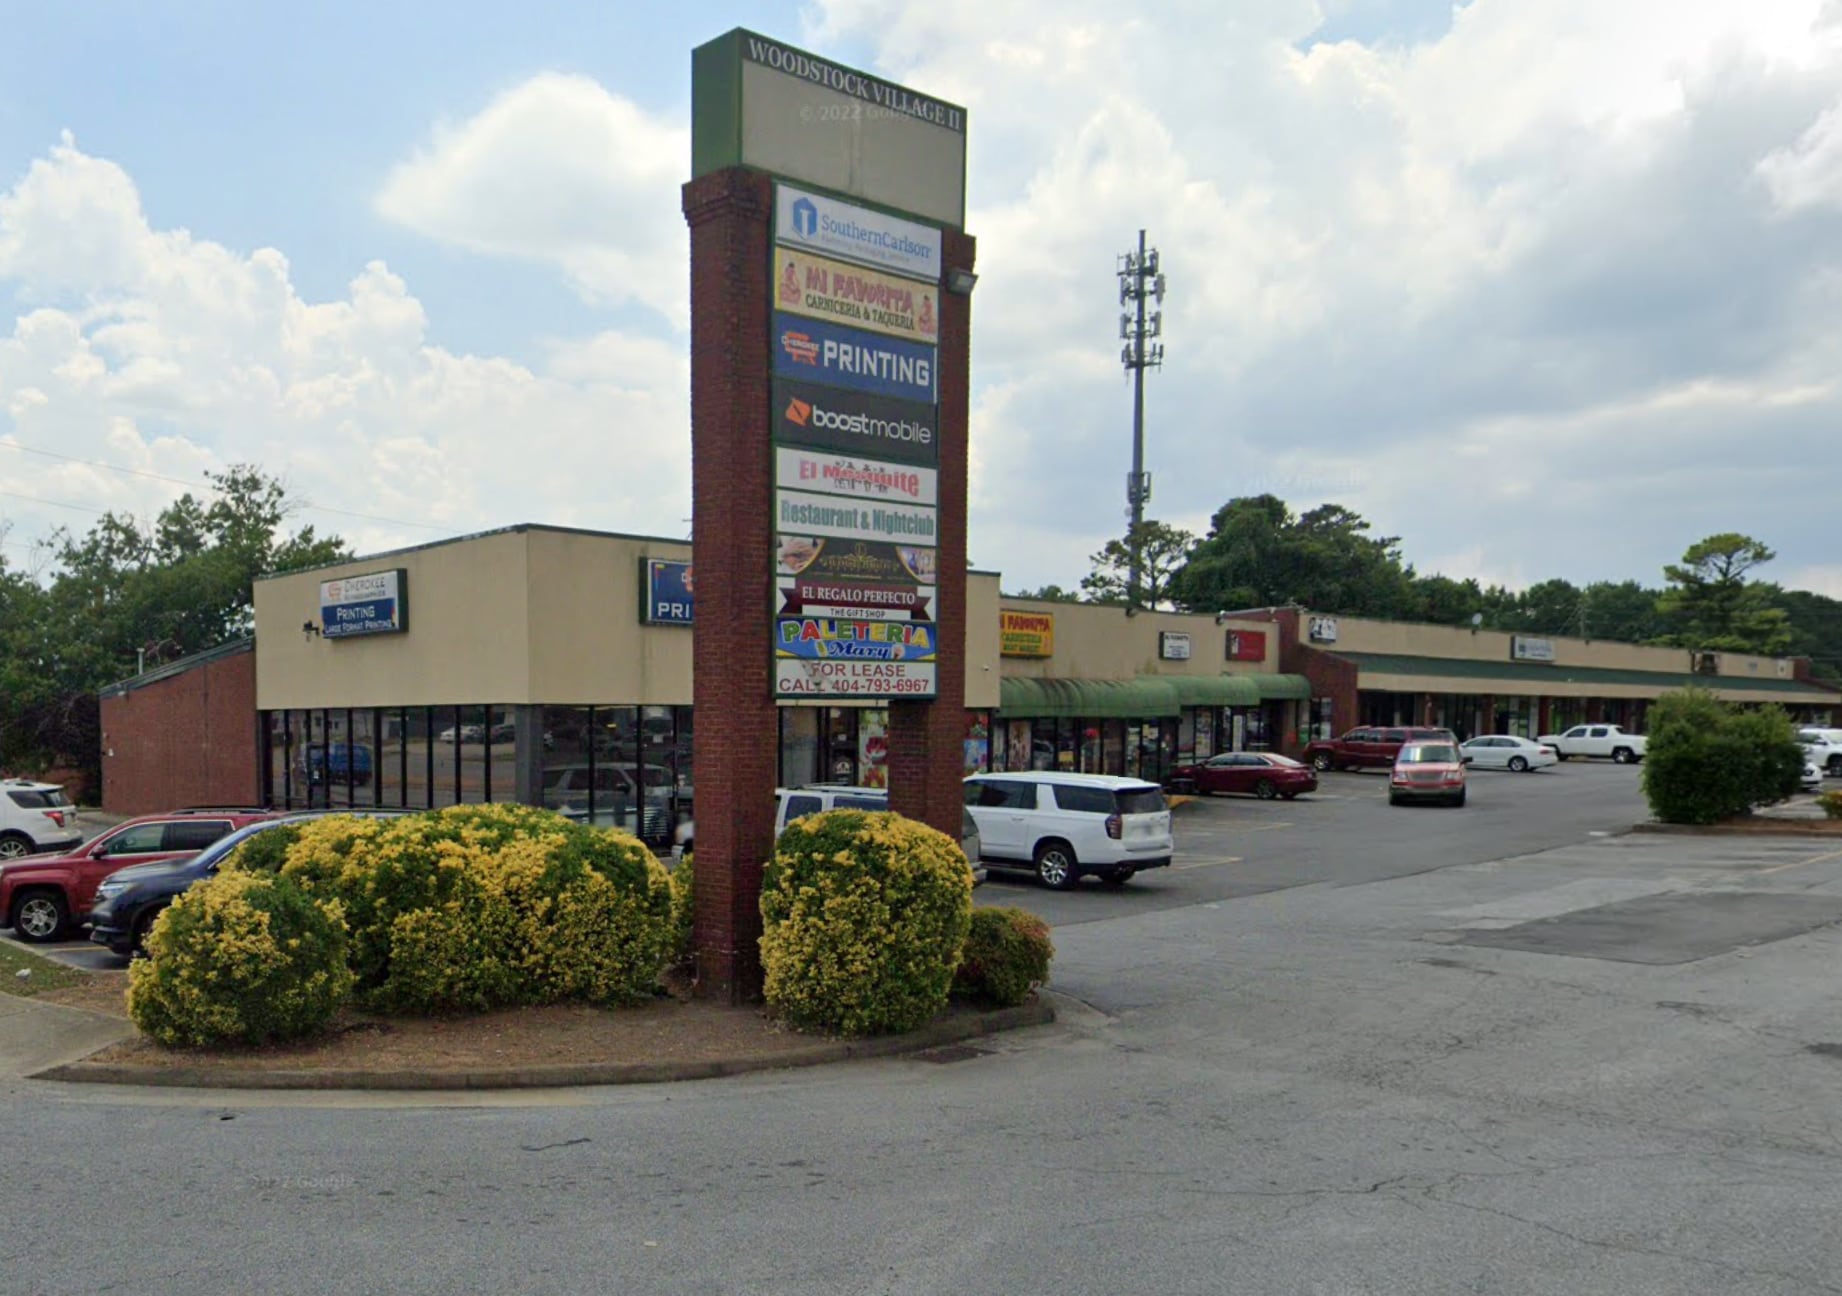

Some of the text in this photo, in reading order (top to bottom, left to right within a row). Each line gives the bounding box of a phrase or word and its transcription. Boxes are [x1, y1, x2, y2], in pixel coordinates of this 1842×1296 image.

[749, 38, 962, 130] WOODSTOCK VILLAGE II
[821, 215, 931, 259] SouthernCarlson
[805, 266, 914, 311] MI FAVORITA
[805, 294, 915, 331] CARNICERIA & TAQUERIA
[823, 339, 930, 386] PRINTING
[780, 499, 934, 536] Restaurant & Nightclub
[802, 586, 917, 605] EL REGALO PERFECTO
[336, 605, 376, 621] PRINTING
[831, 608, 886, 618] THE GIFT SHOP
[781, 619, 930, 649] PALETERIA
[828, 641, 891, 660] Mary
[808, 662, 906, 677] FOR LEASE
[779, 678, 929, 693] CALL 404-793-6967
